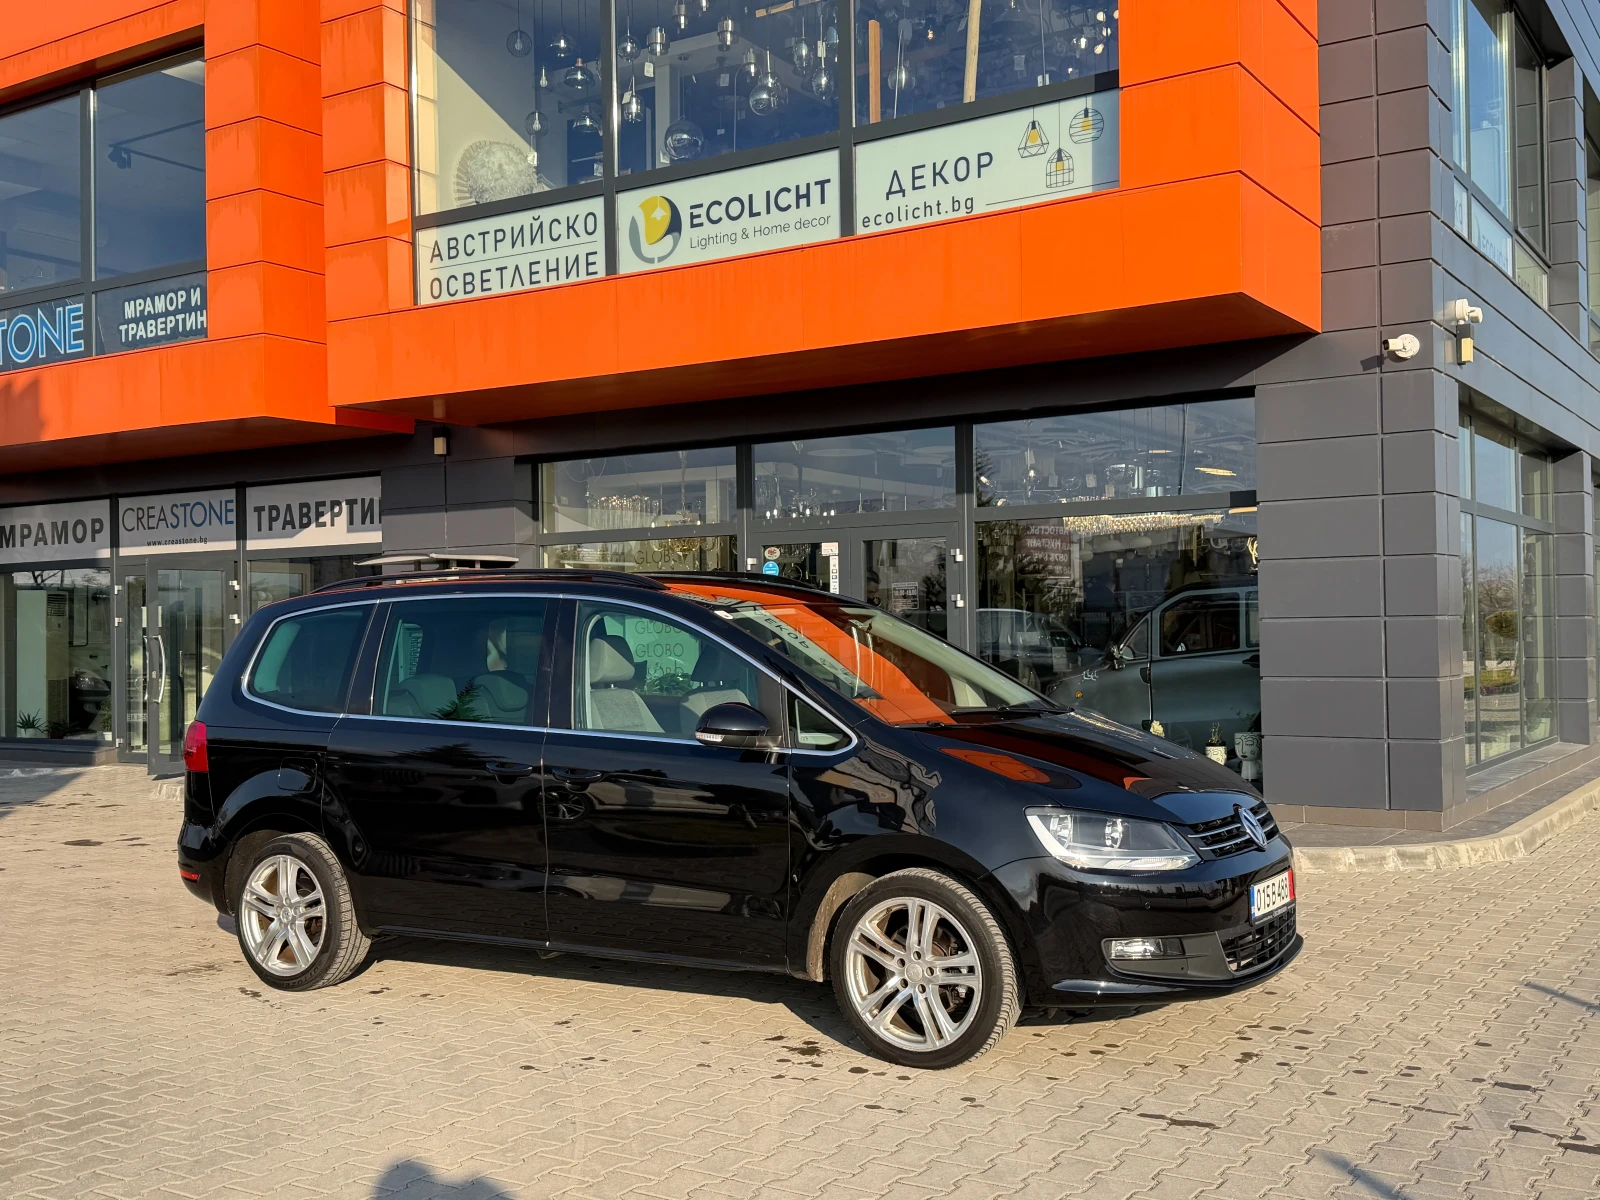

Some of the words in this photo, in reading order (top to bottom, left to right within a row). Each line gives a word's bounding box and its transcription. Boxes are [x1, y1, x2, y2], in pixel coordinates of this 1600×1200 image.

[886, 151, 994, 200] ДЕКОР
[689, 178, 831, 229] ECOLICHT
[861, 196, 974, 228] ecolicht.bg
[430, 211, 598, 263] АВСТРИЙСКО
[690, 231, 738, 250] Lighting
[741, 229, 750, 240] &
[753, 221, 791, 238] Home
[794, 215, 831, 230] decor
[430, 250, 598, 300] ОСВЕТЛЕНИЕ
[124, 290, 187, 320] МРАМОР
[190, 287, 201, 307] И
[119, 309, 207, 342] ТРАВЕРТИН
[121, 499, 234, 532] CREASTONE
[253, 496, 381, 532] ТРАВЕРТИ
[0, 517, 104, 549] МРАМОР
[146, 536, 208, 547] www.creastone.bg
[634, 549, 679, 565] GLOB
[635, 642, 685, 658] GLOBO
